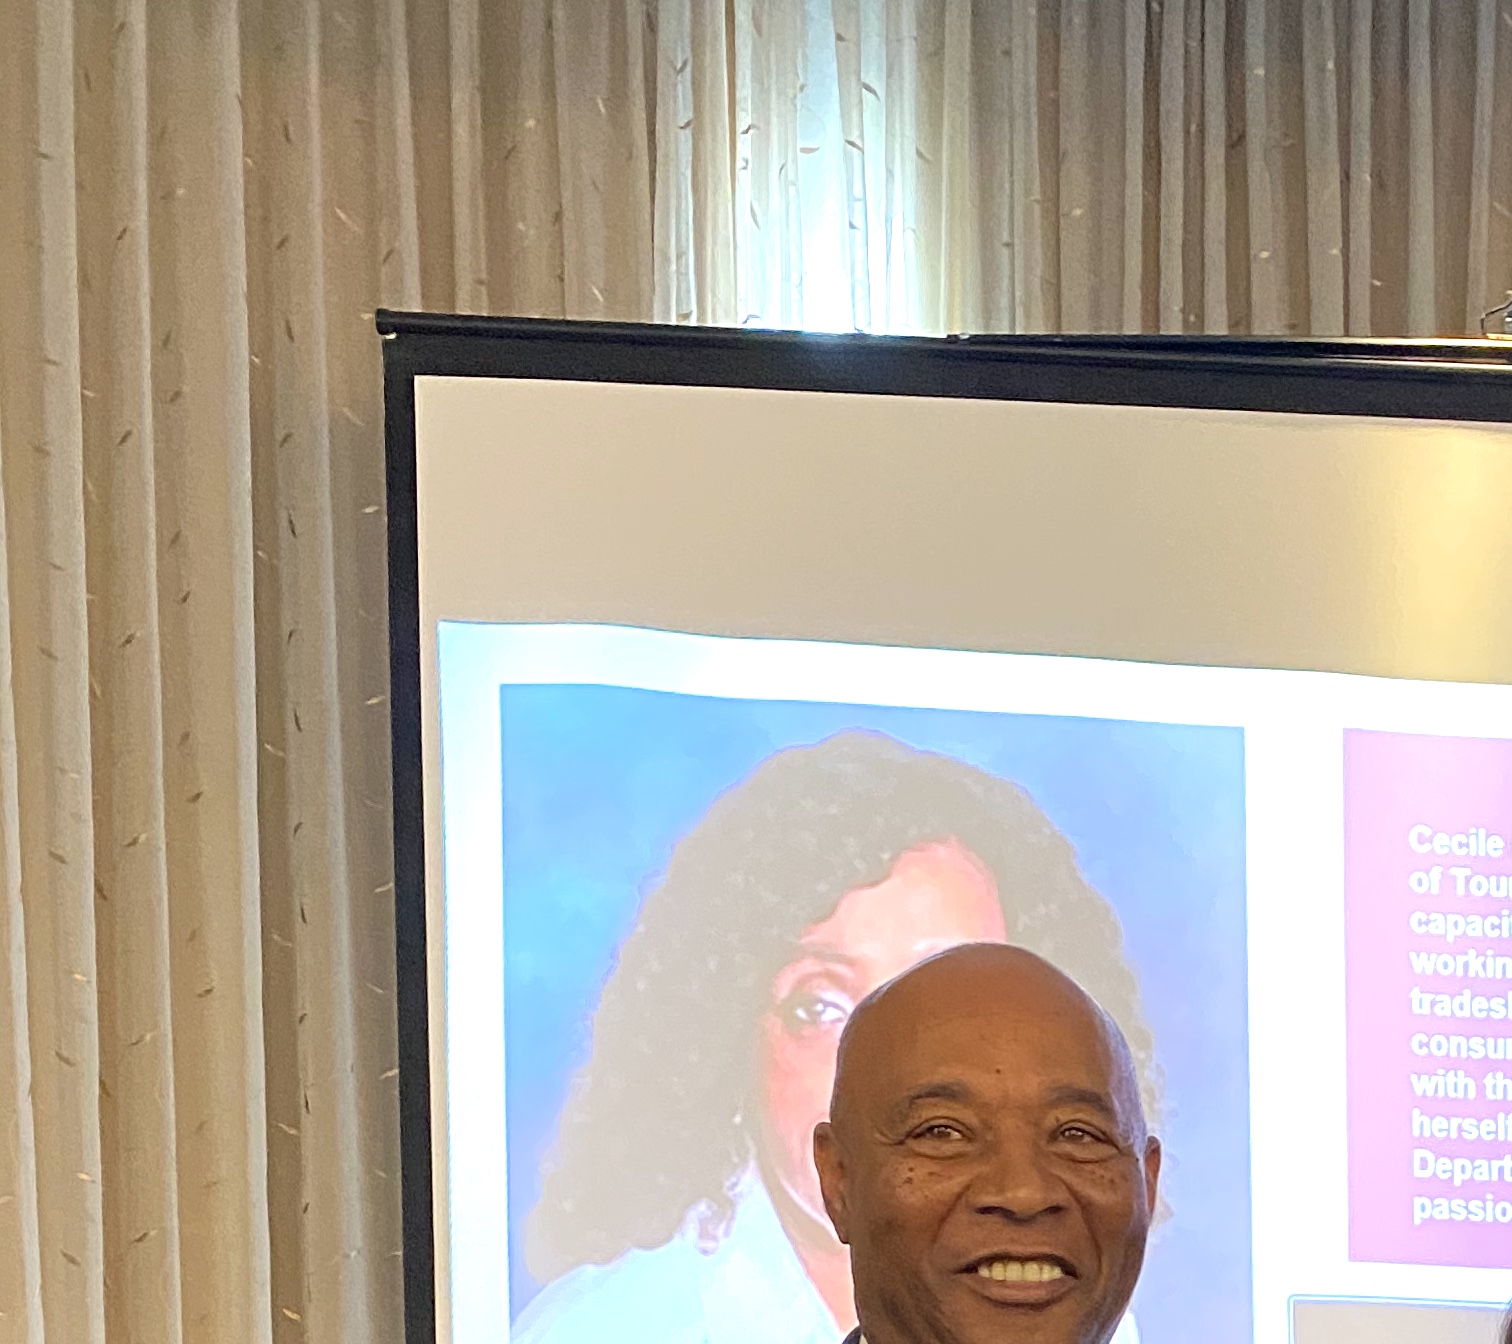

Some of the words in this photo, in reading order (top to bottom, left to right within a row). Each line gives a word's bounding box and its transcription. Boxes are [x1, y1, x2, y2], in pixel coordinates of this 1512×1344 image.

[1408, 825, 1504, 859] Cecile
[1409, 866, 1443, 894] of
[1411, 1069, 1476, 1099] with
